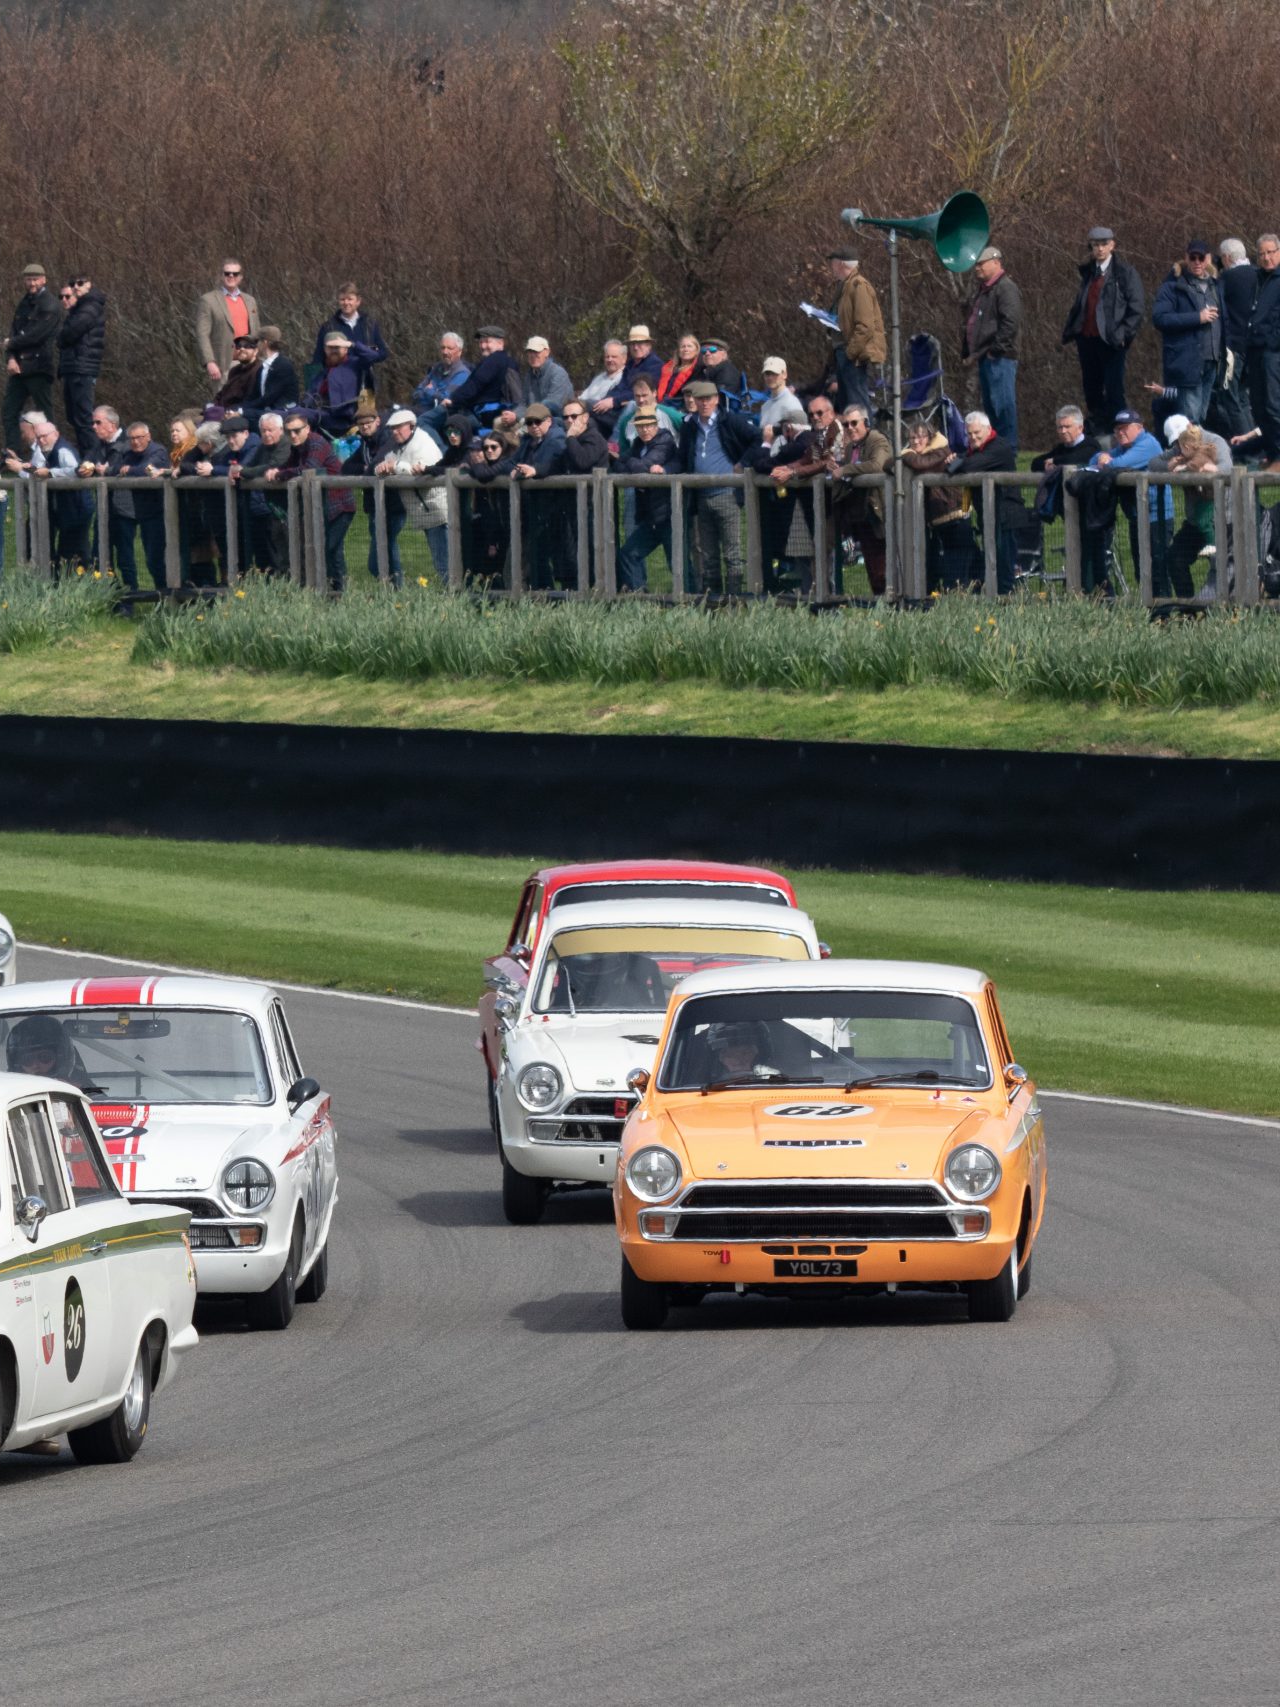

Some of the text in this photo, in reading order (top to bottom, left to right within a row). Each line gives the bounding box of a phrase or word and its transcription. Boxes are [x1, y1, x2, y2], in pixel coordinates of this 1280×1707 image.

[773, 1105, 865, 1116] 68
[790, 1262, 842, 1275] YOL73
[65, 1304, 83, 1350] 26
